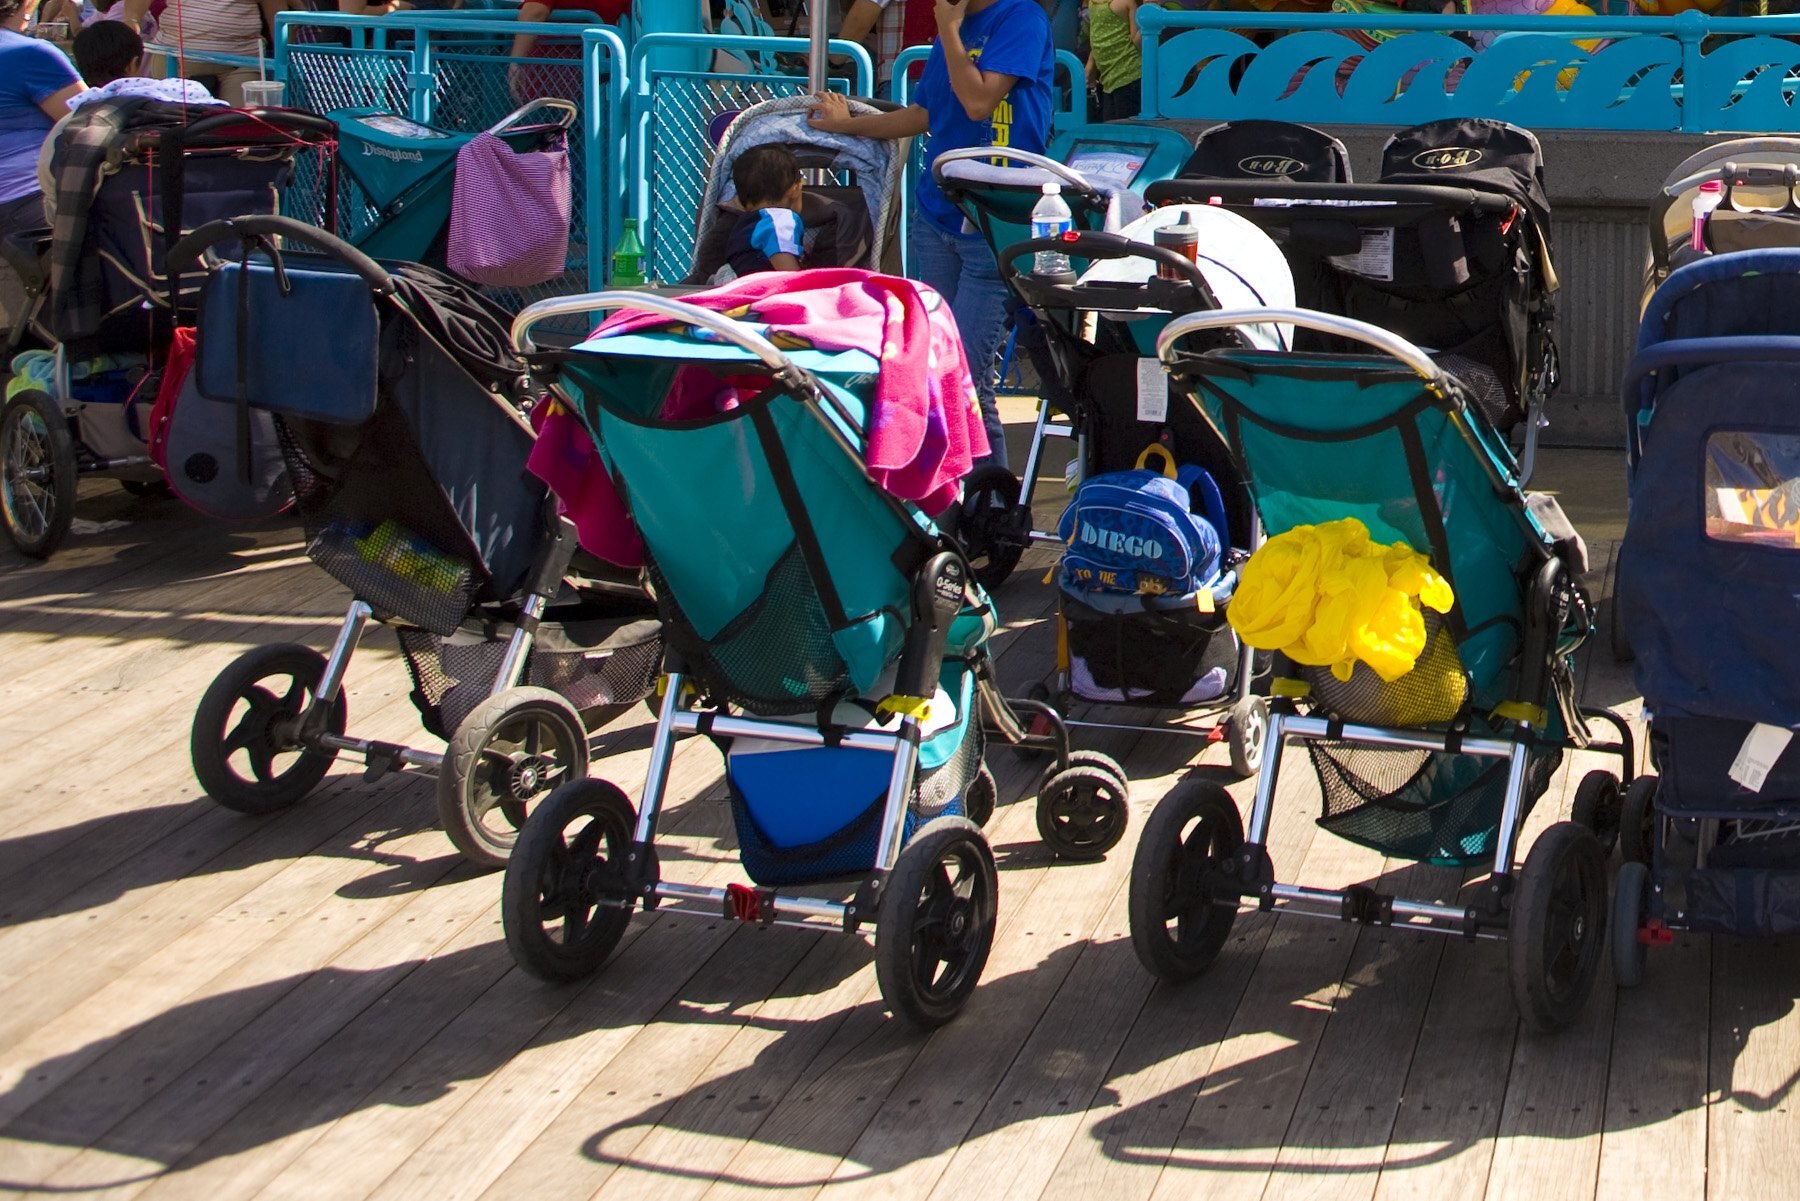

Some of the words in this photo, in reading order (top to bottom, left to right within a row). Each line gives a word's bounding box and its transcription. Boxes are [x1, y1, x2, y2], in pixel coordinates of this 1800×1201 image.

[361, 140, 423, 162] Disneyland
[1081, 521, 1162, 559] DIEGO
[1075, 568, 1092, 580] TO
[1099, 570, 1117, 585] THE
